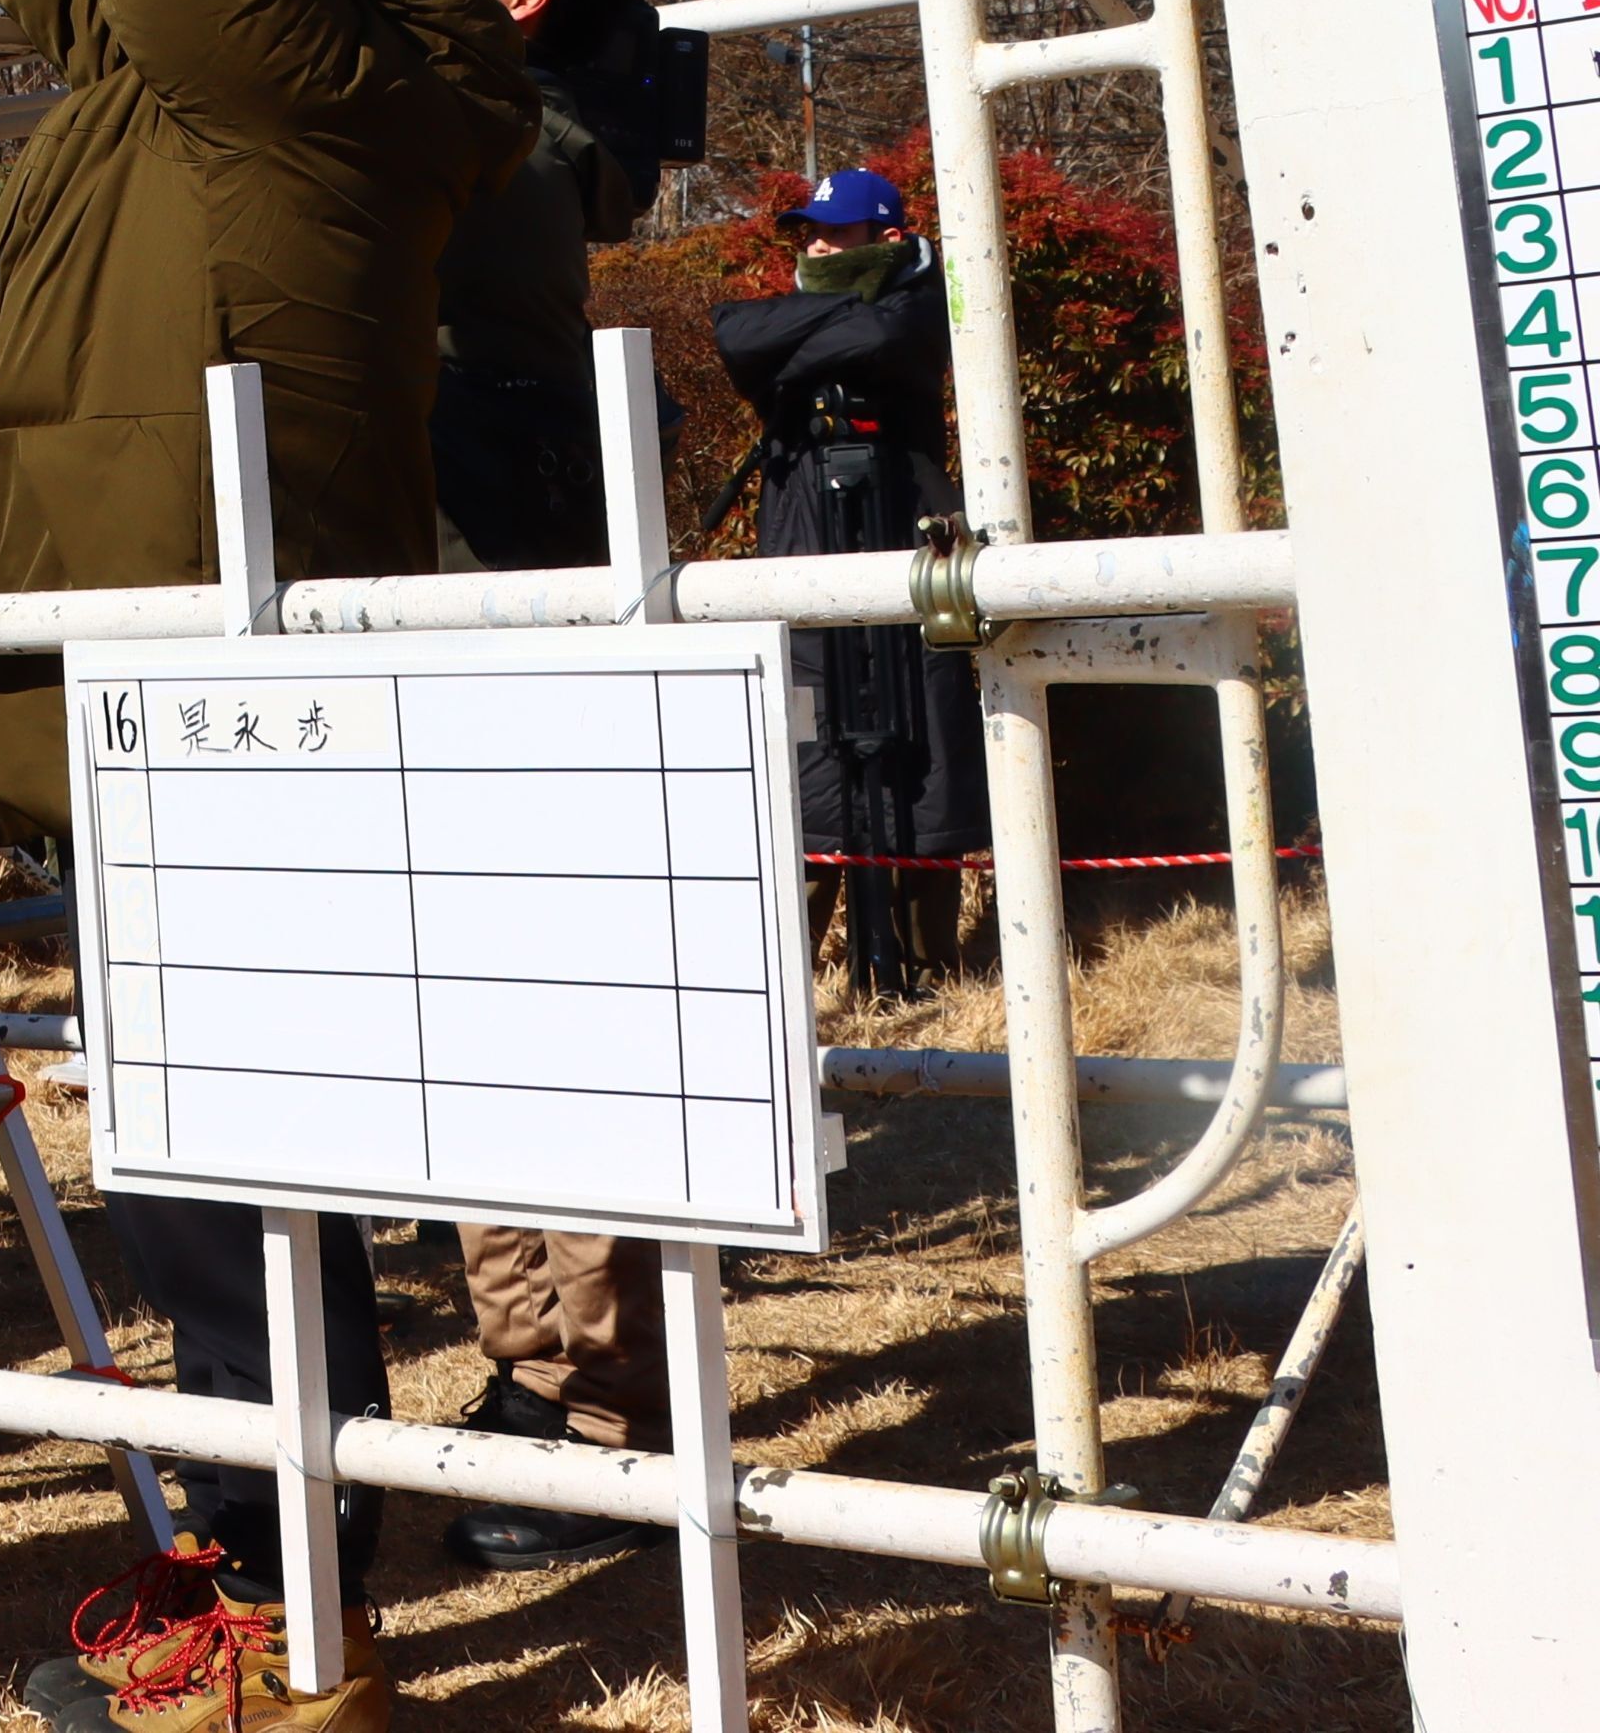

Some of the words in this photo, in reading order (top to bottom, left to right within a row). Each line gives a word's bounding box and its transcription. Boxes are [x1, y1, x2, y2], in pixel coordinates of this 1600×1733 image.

[1478, 36, 1516, 105] 1
[1486, 119, 1548, 191] 2
[1495, 203, 1558, 274] 3
[1505, 288, 1572, 358] 4
[1518, 372, 1579, 444] 5
[1528, 458, 1590, 529] 6
[1536, 546, 1599, 617] 7
[1550, 634, 1600, 706] 8
[101, 691, 138, 754] 16
[1560, 721, 1600, 792] 9
[1564, 808, 1600, 877] 1
